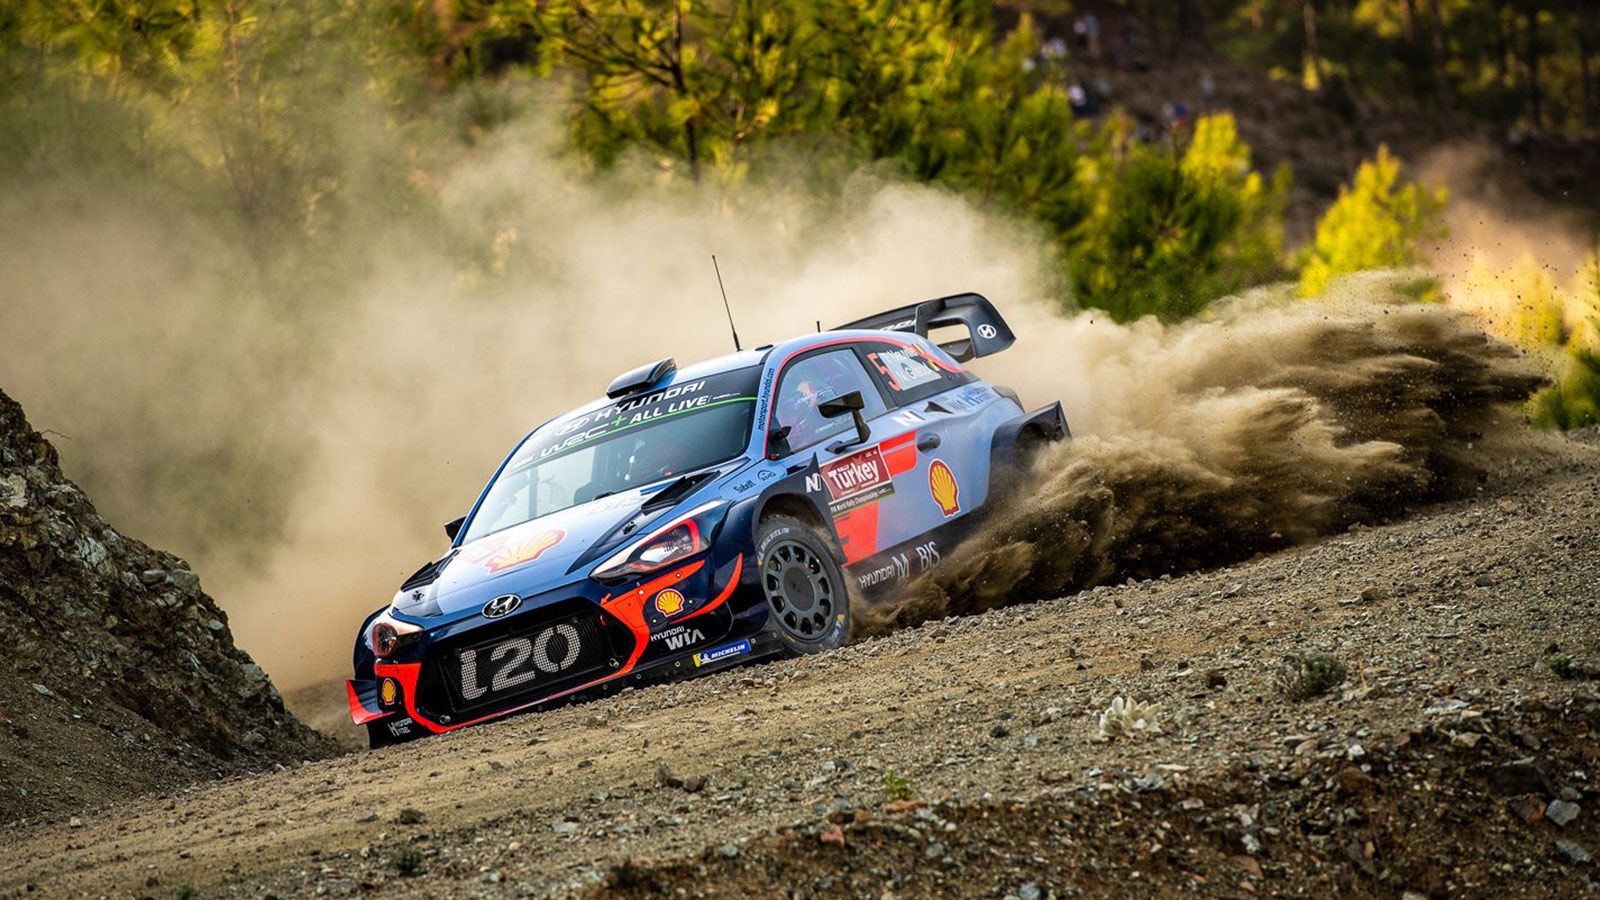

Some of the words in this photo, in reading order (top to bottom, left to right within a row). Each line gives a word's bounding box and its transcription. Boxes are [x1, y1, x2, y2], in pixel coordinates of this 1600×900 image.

[594, 380, 706, 422] HYUNDAI
[629, 407, 663, 425] ALL
[667, 395, 708, 413] LIVE
[828, 460, 880, 490] Turkey
[858, 564, 896, 589] HYUNDAI
[650, 625, 686, 642] HYUNDAI
[711, 643, 746, 659] MICHELIN
